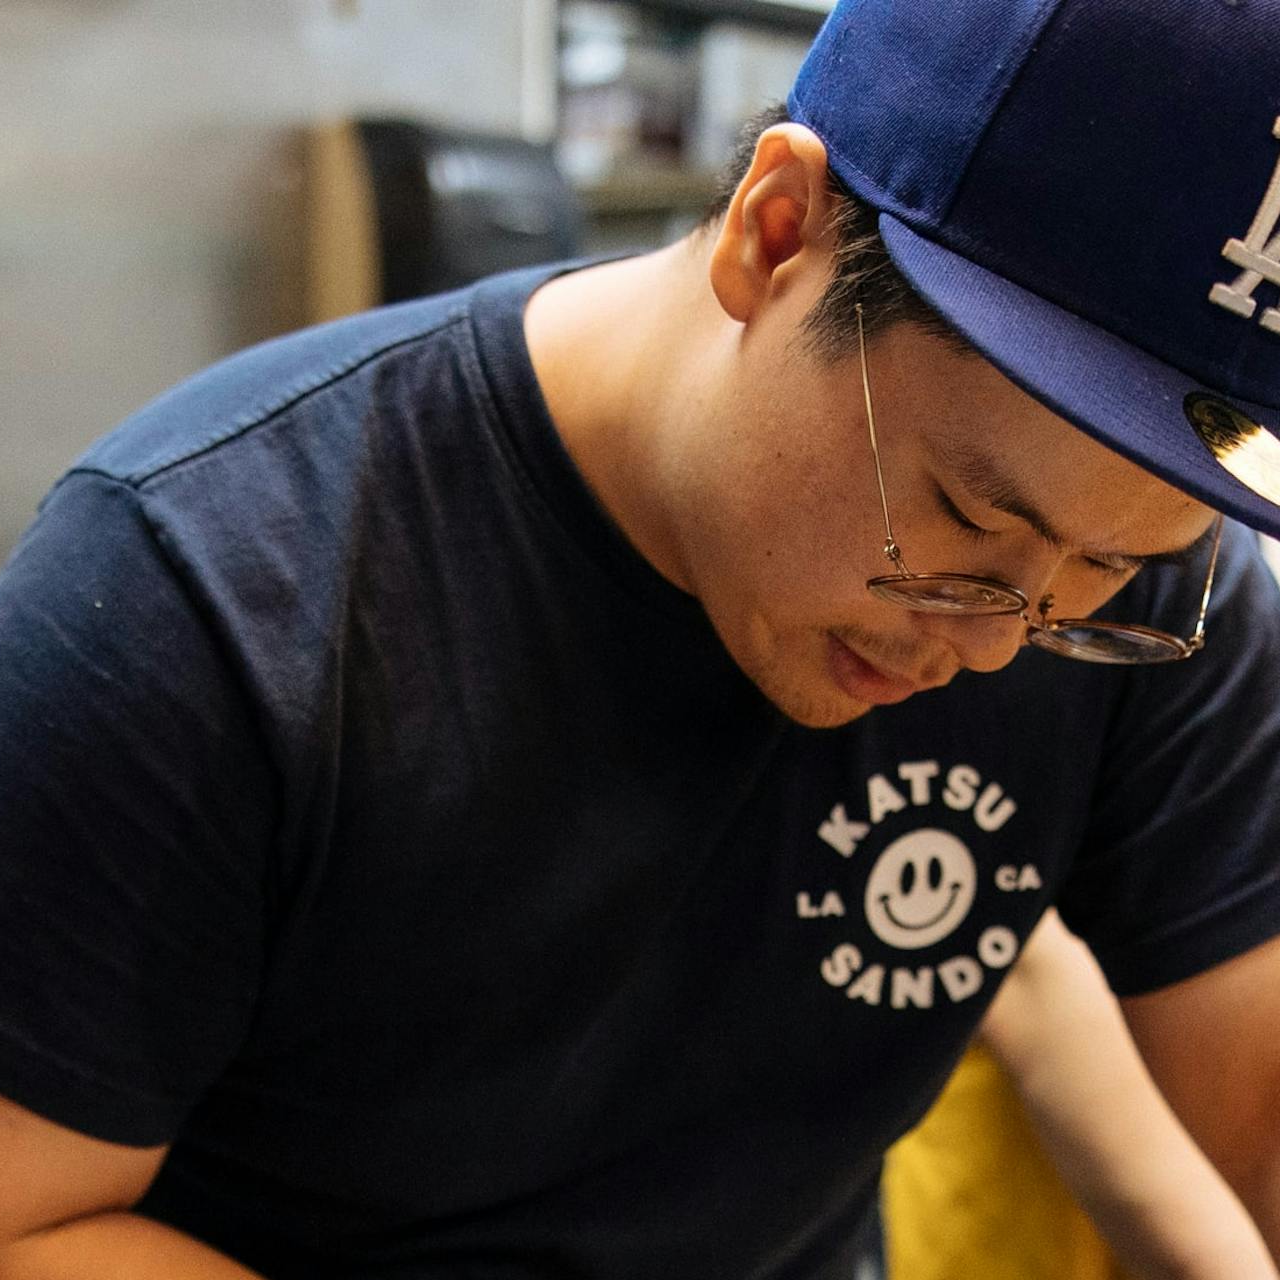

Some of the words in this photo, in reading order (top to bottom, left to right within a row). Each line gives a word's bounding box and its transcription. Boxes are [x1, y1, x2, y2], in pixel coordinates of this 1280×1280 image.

[817, 760, 1018, 858] KATSU
[796, 891, 845, 919] LA
[994, 864, 1043, 892] CA
[821, 925, 1019, 1010] SANDO
